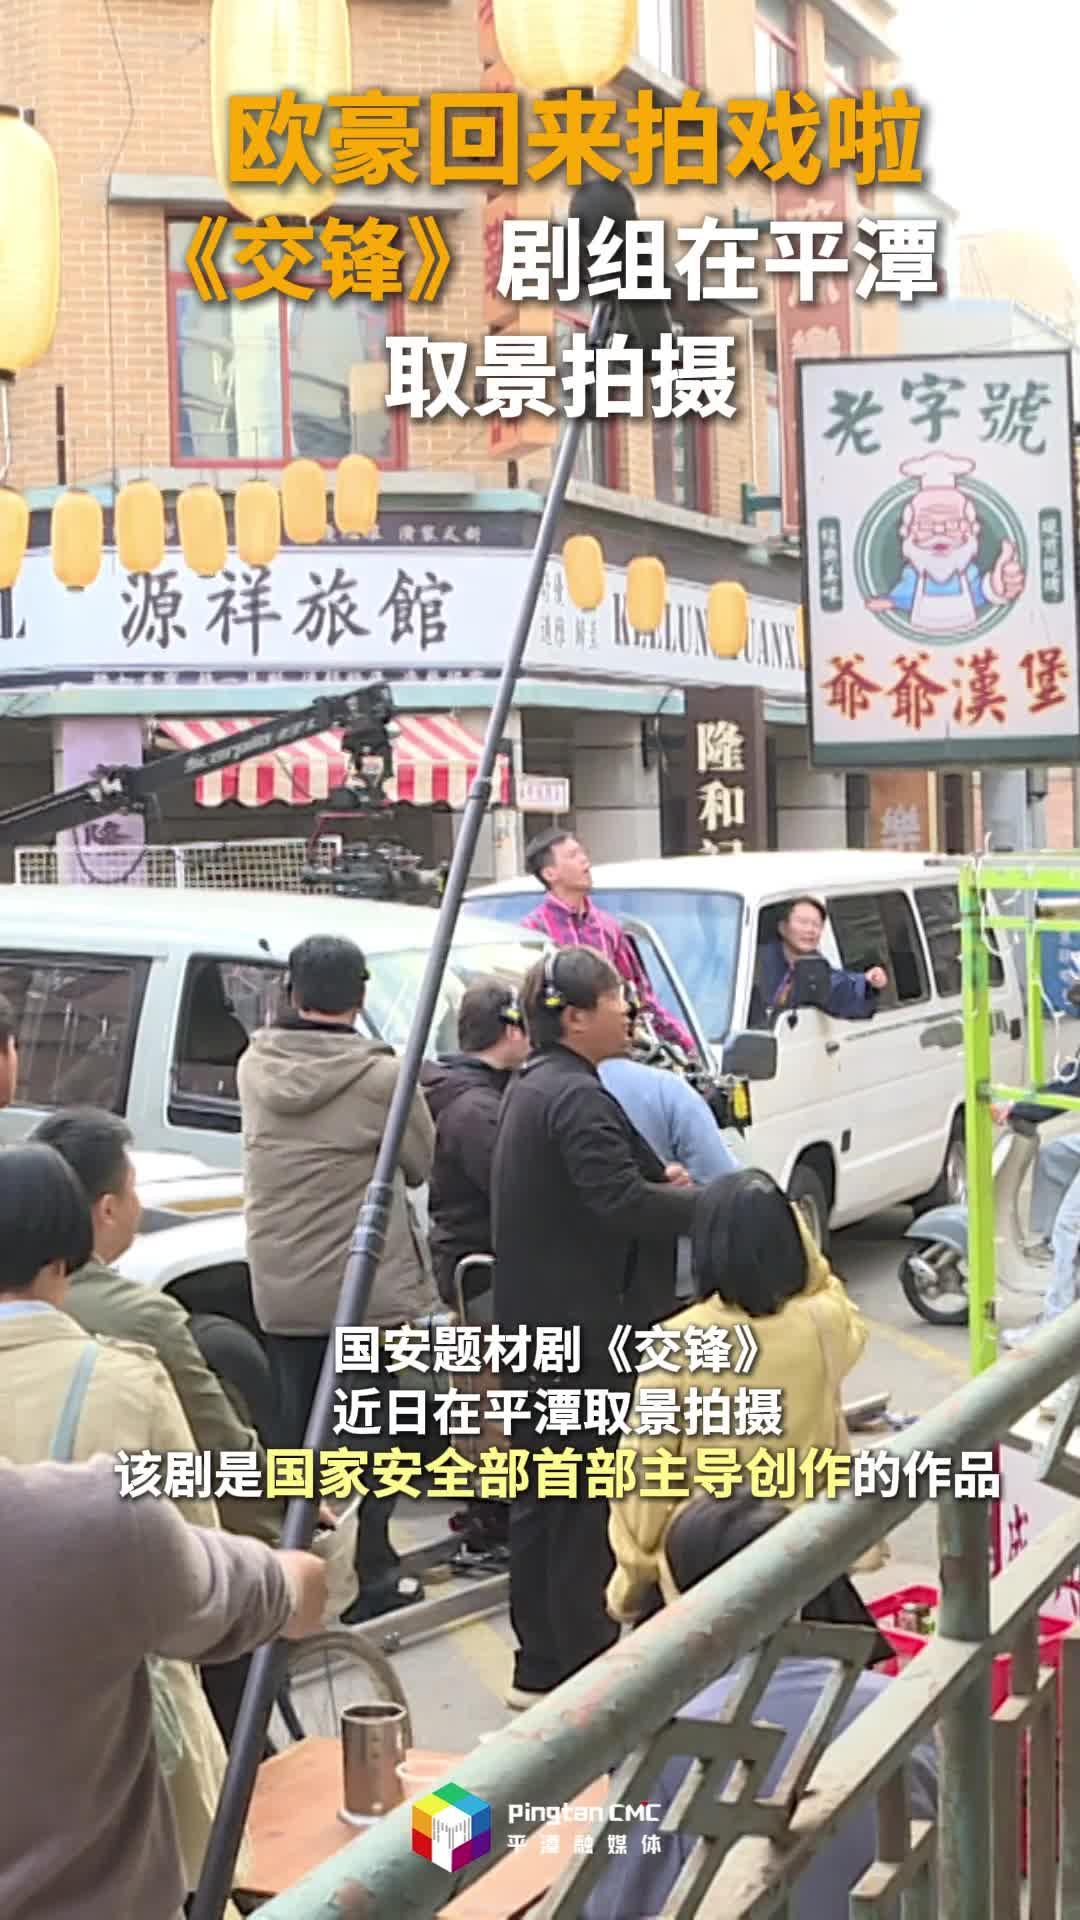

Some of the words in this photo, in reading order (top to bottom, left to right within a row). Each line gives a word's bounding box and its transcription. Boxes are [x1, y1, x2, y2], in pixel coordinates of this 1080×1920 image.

[823, 372, 1052, 456] 老字號
[121, 565, 454, 656] 源祥旅館
[821, 645, 1070, 731] 爺爺漢堡
